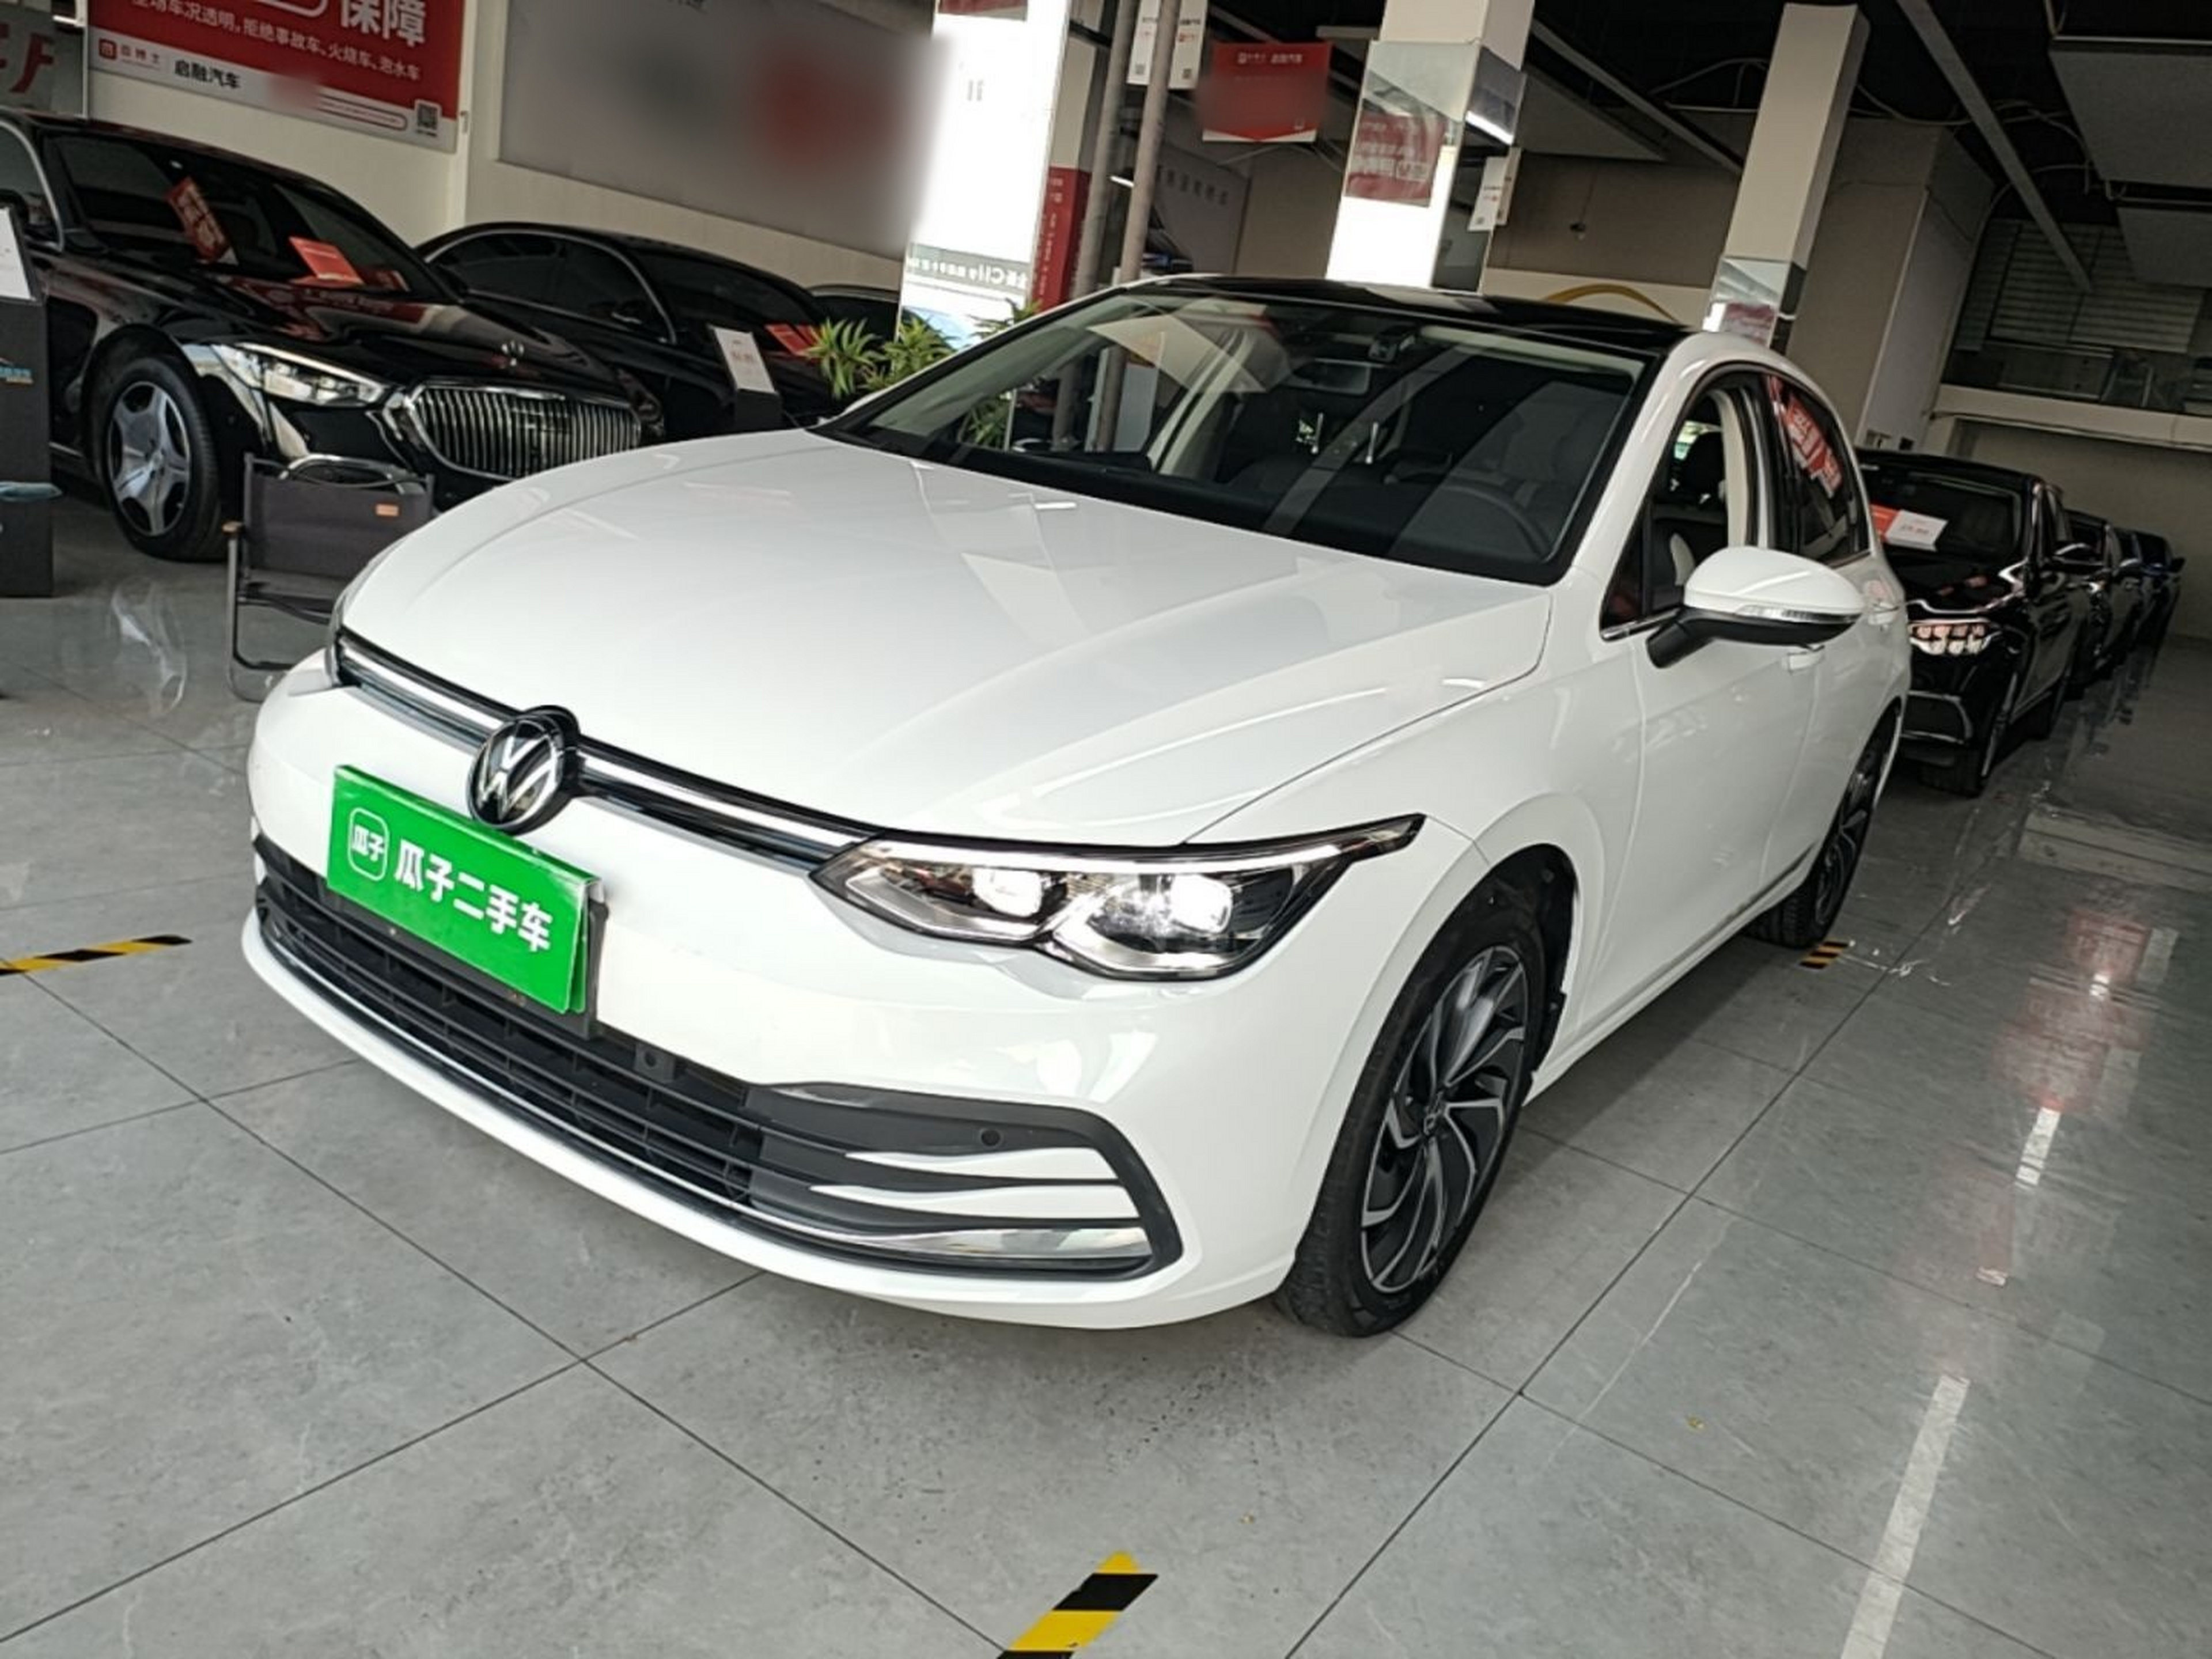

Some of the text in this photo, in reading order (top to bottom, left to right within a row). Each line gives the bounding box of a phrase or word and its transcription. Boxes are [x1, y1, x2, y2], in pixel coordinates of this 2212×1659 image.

[340, 0, 426, 47] 保障
[175, 59, 241, 89] 启融汽车
[352, 826, 385, 862] 瓜子
[395, 839, 553, 952] 瓜子二手车
